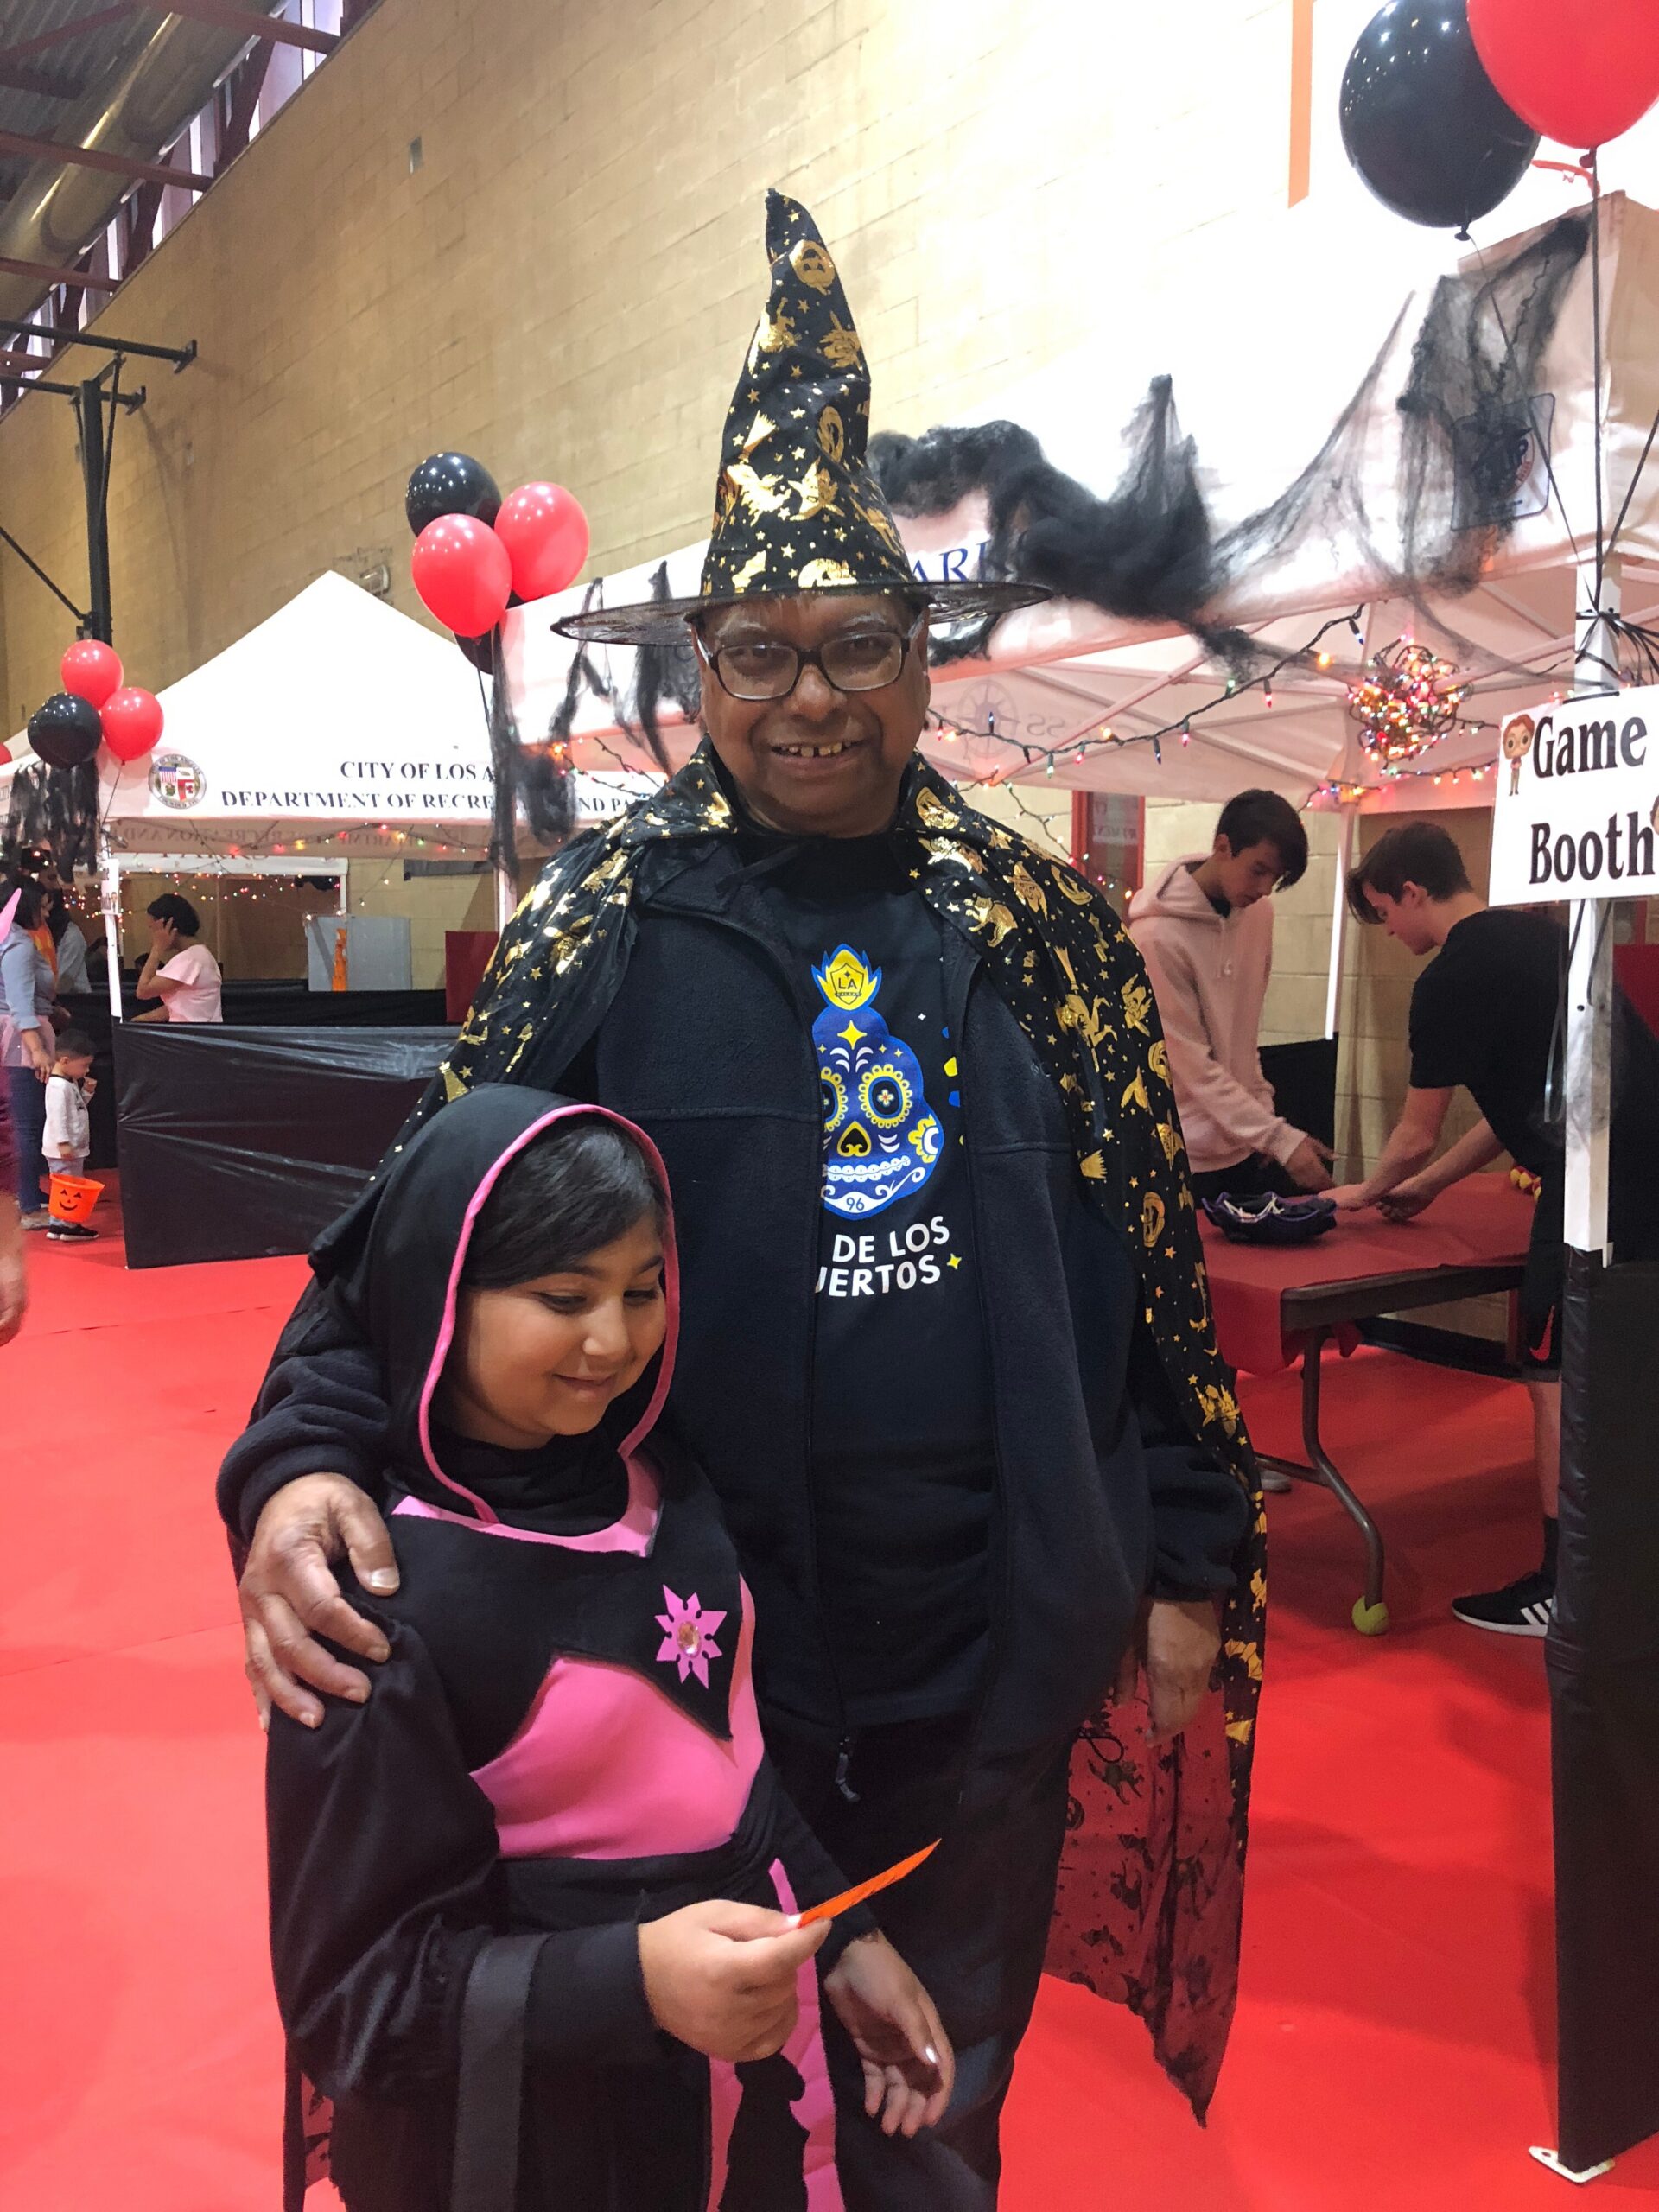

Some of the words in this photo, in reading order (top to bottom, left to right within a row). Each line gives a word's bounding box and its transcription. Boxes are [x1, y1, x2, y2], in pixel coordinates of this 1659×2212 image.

[1533, 715, 1648, 779] Game
[340, 761, 394, 779] CITY
[400, 762, 430, 779] OF
[435, 763, 477, 781] LOS
[221, 791, 381, 809] DEPARTMENT
[387, 793, 416, 809] OF
[1529, 811, 1656, 884] Booth
[838, 977, 857, 989] LA
[846, 1197, 865, 1211] 96
[832, 1234, 875, 1263] DE
[889, 1216, 950, 1257] LOS
